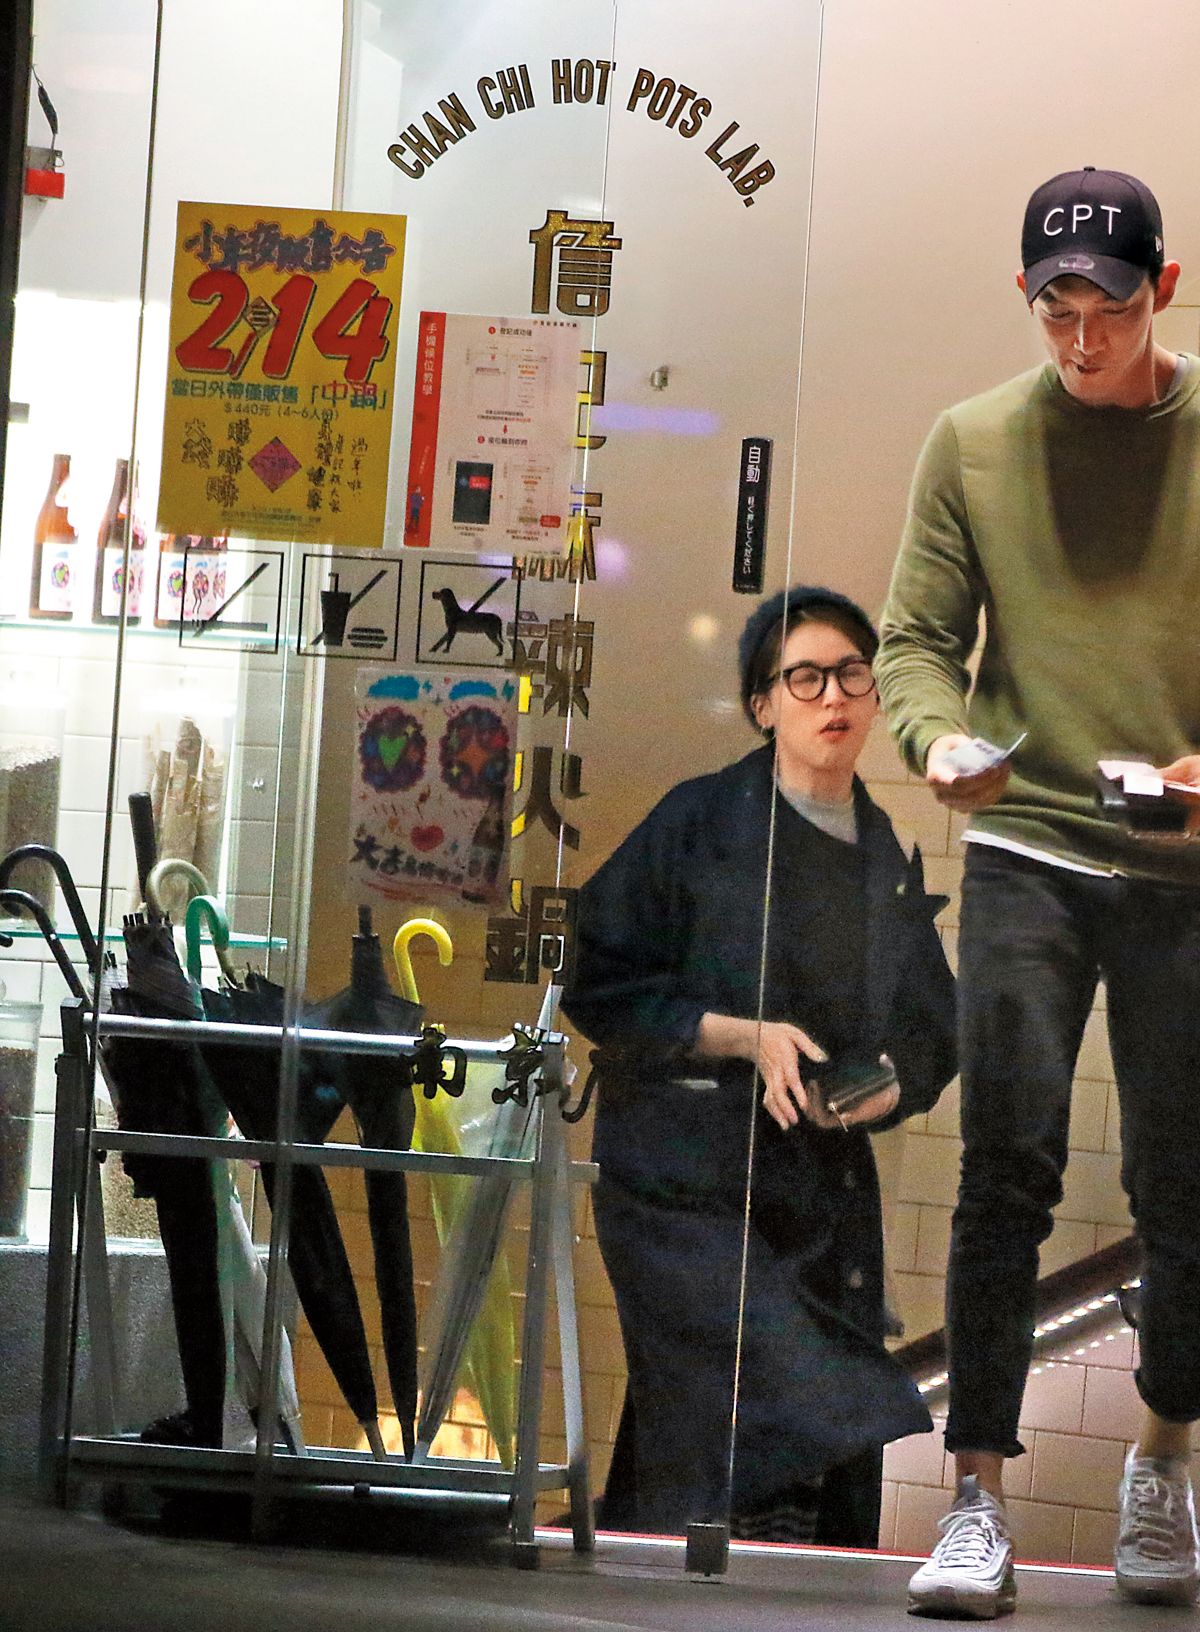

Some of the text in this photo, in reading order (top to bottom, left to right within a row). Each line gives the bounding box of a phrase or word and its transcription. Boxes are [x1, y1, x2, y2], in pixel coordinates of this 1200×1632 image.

[387, 58, 776, 208] CHAN CHI HOT POTS LAB.
[1043, 204, 1121, 236] CPT
